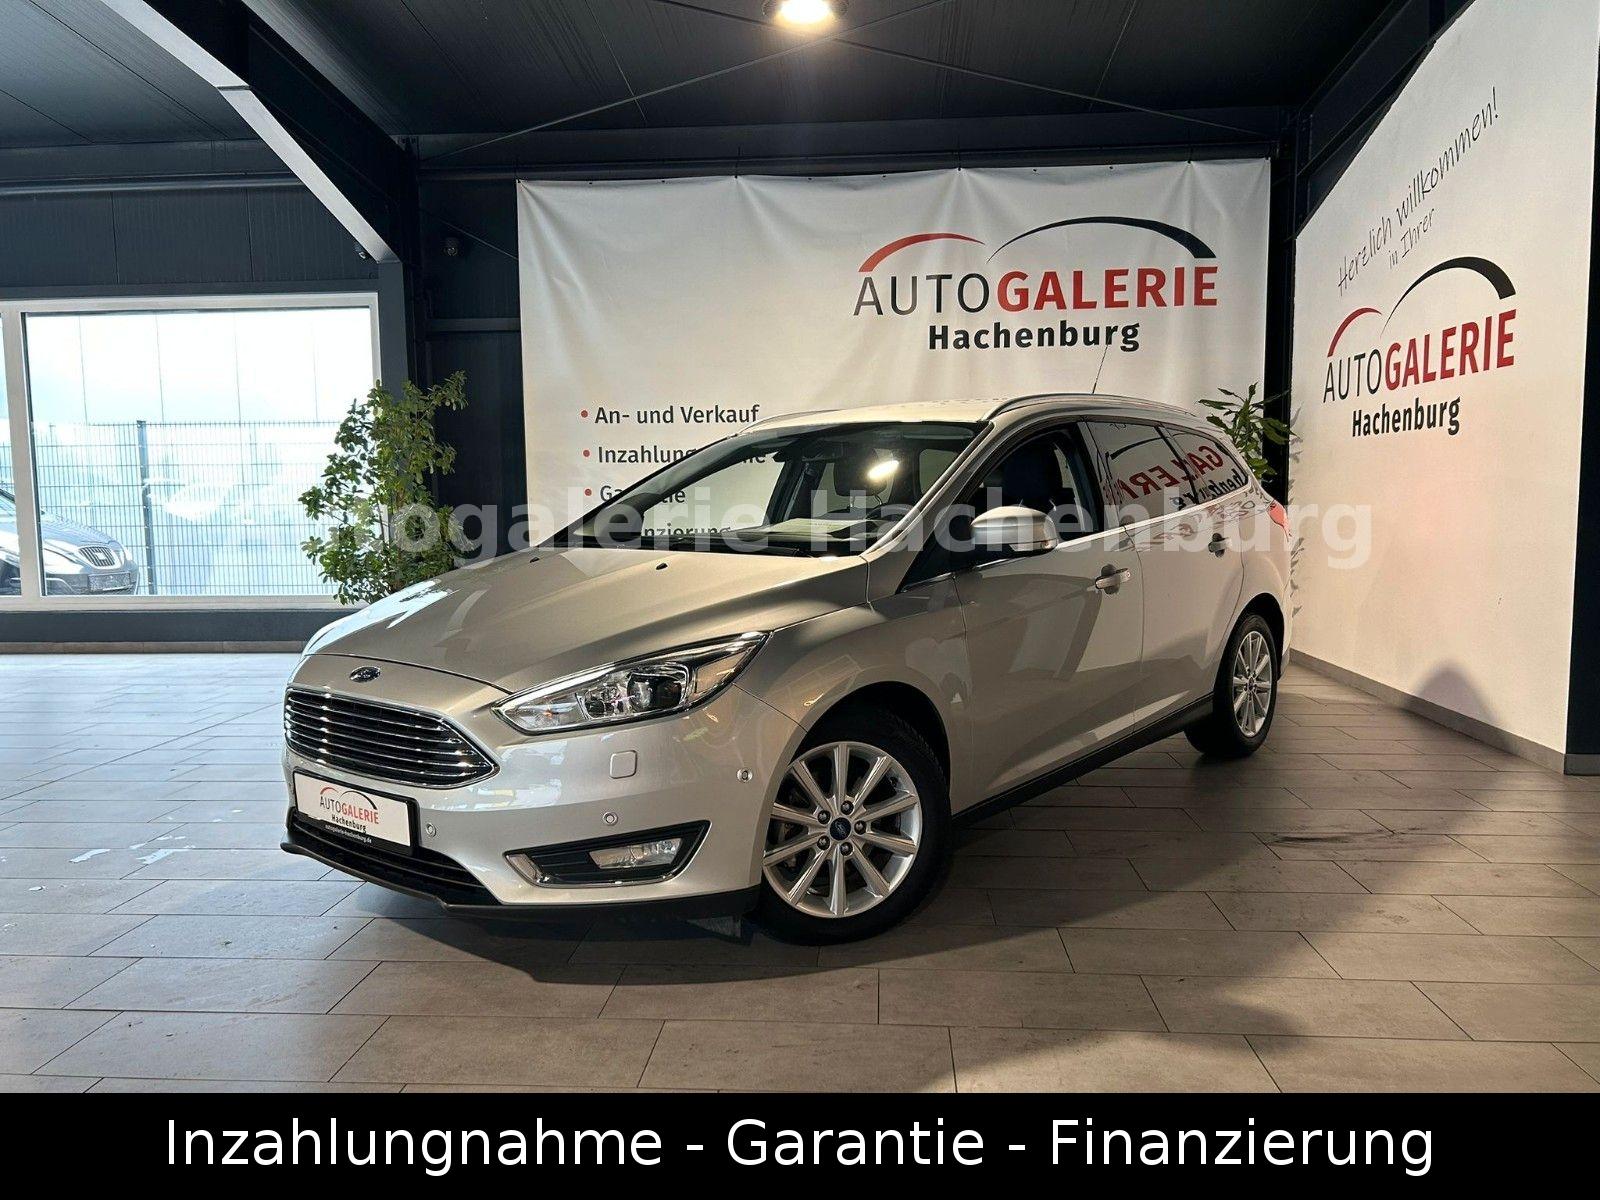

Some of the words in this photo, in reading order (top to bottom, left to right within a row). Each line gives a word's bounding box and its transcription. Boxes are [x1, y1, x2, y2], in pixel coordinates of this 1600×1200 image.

[1338, 216, 1392, 296] Herzlich
[1396, 86, 1499, 226] willkommen!
[1389, 250, 1399, 269] in
[1400, 208, 1435, 258] Ihrer
[853, 265, 1219, 316] AUTOGALERIE
[929, 320, 1140, 353] Hachenburg
[1323, 308, 1518, 403] AUTOGALERIE
[595, 407, 630, 424] An-
[637, 405, 674, 424] und
[680, 404, 760, 424] Verkauf
[1352, 396, 1461, 437] Hachenburg
[320, 796, 379, 824] AUTOGALERIE
[332, 814, 367, 833] Hachenburg
